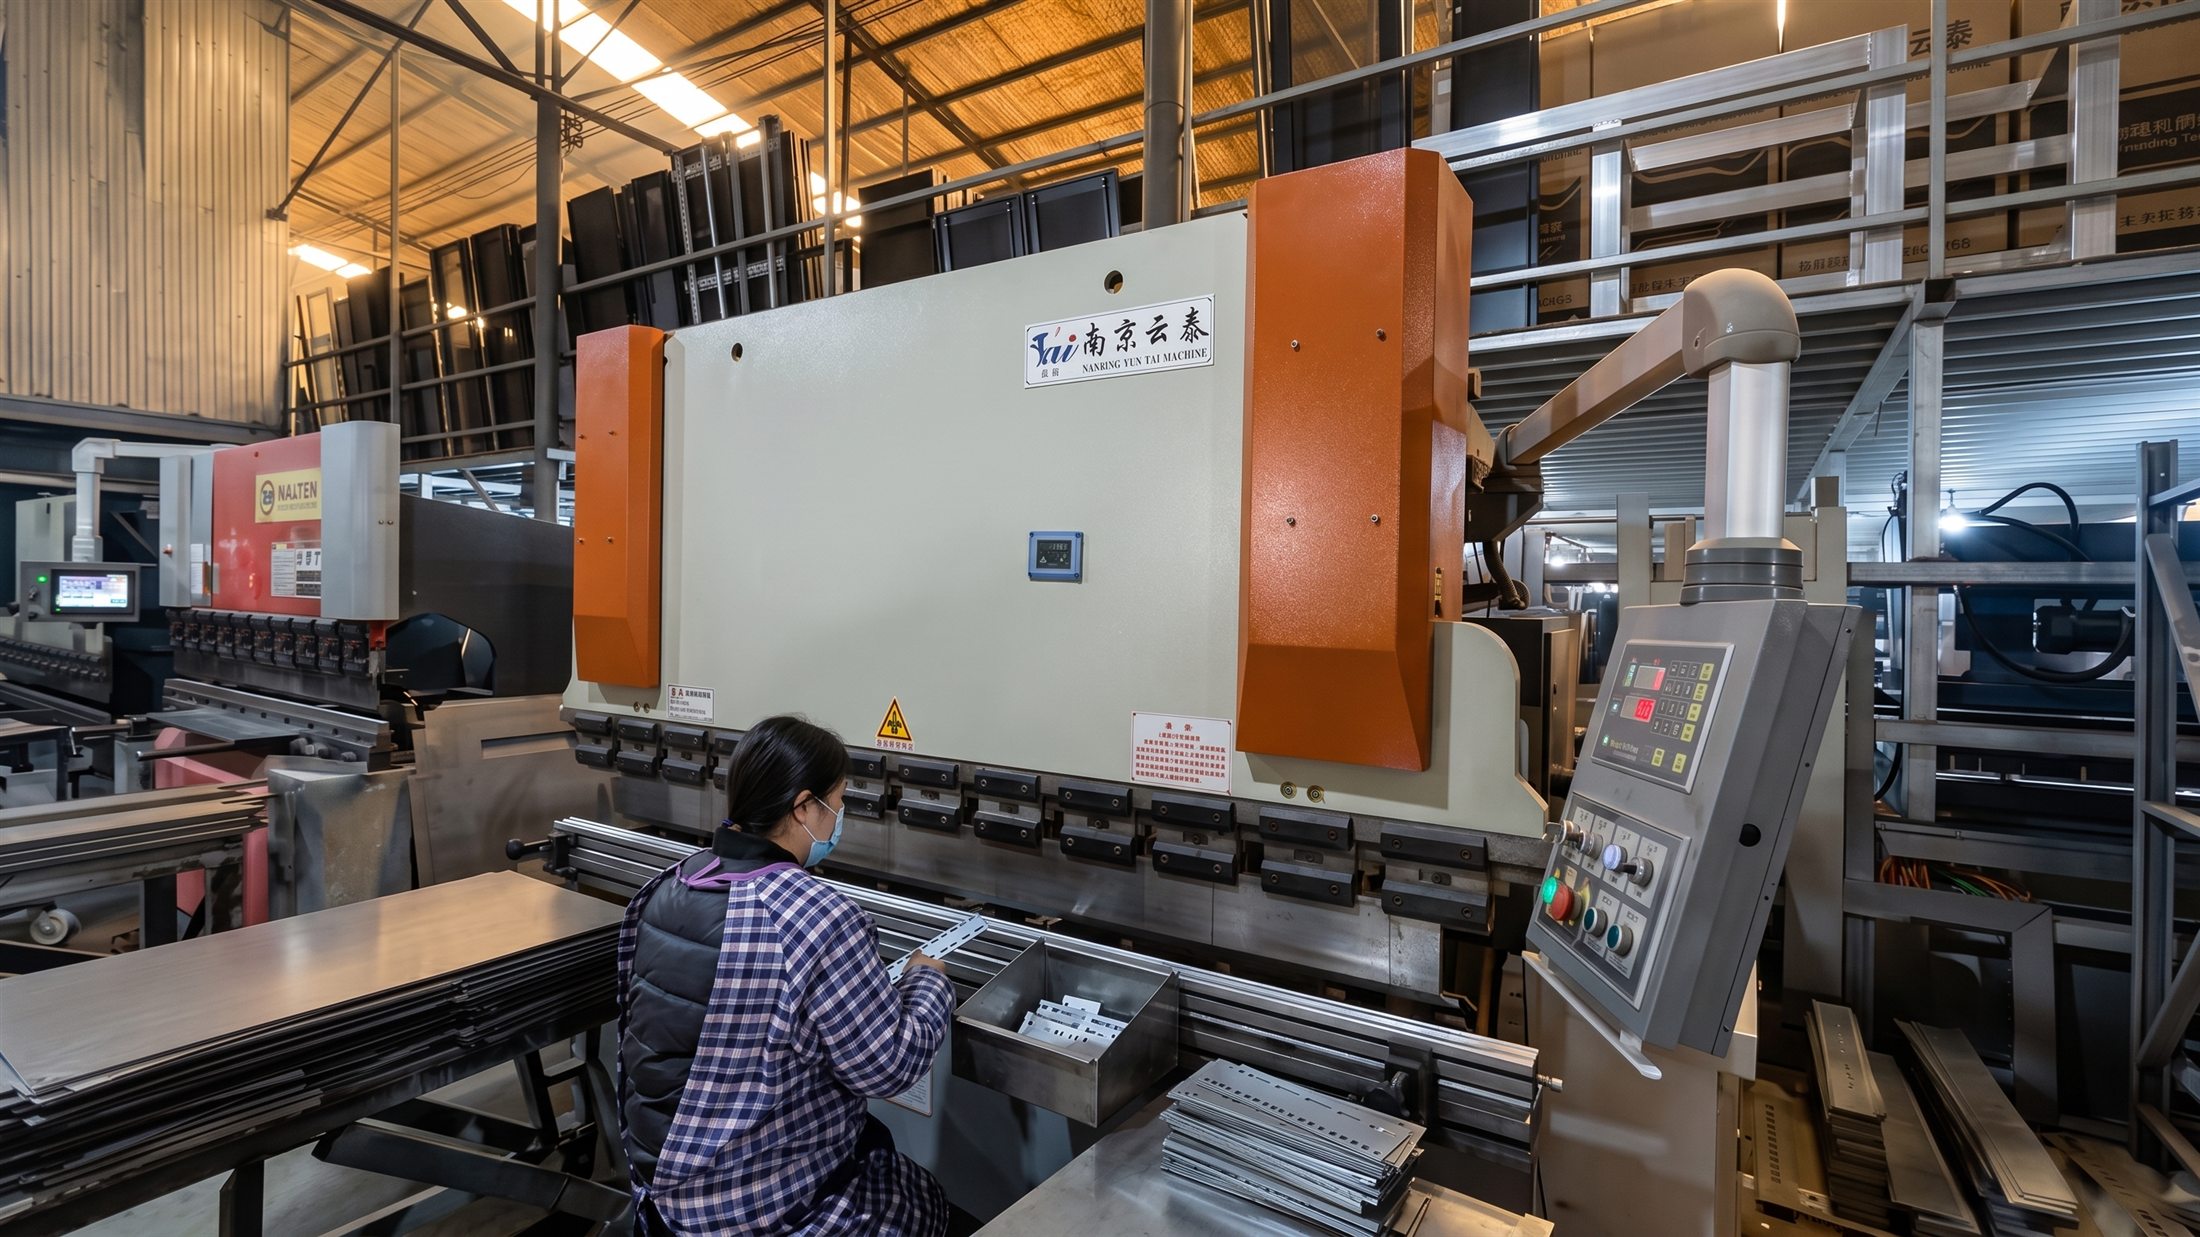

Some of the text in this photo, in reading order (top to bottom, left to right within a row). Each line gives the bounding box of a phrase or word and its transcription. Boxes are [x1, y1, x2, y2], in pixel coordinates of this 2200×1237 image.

[1083, 306, 1210, 357] 南京云泰
[1123, 356, 1142, 368] YUN
[1144, 354, 1160, 365] TAI
[1162, 347, 1208, 362] MACHINE
